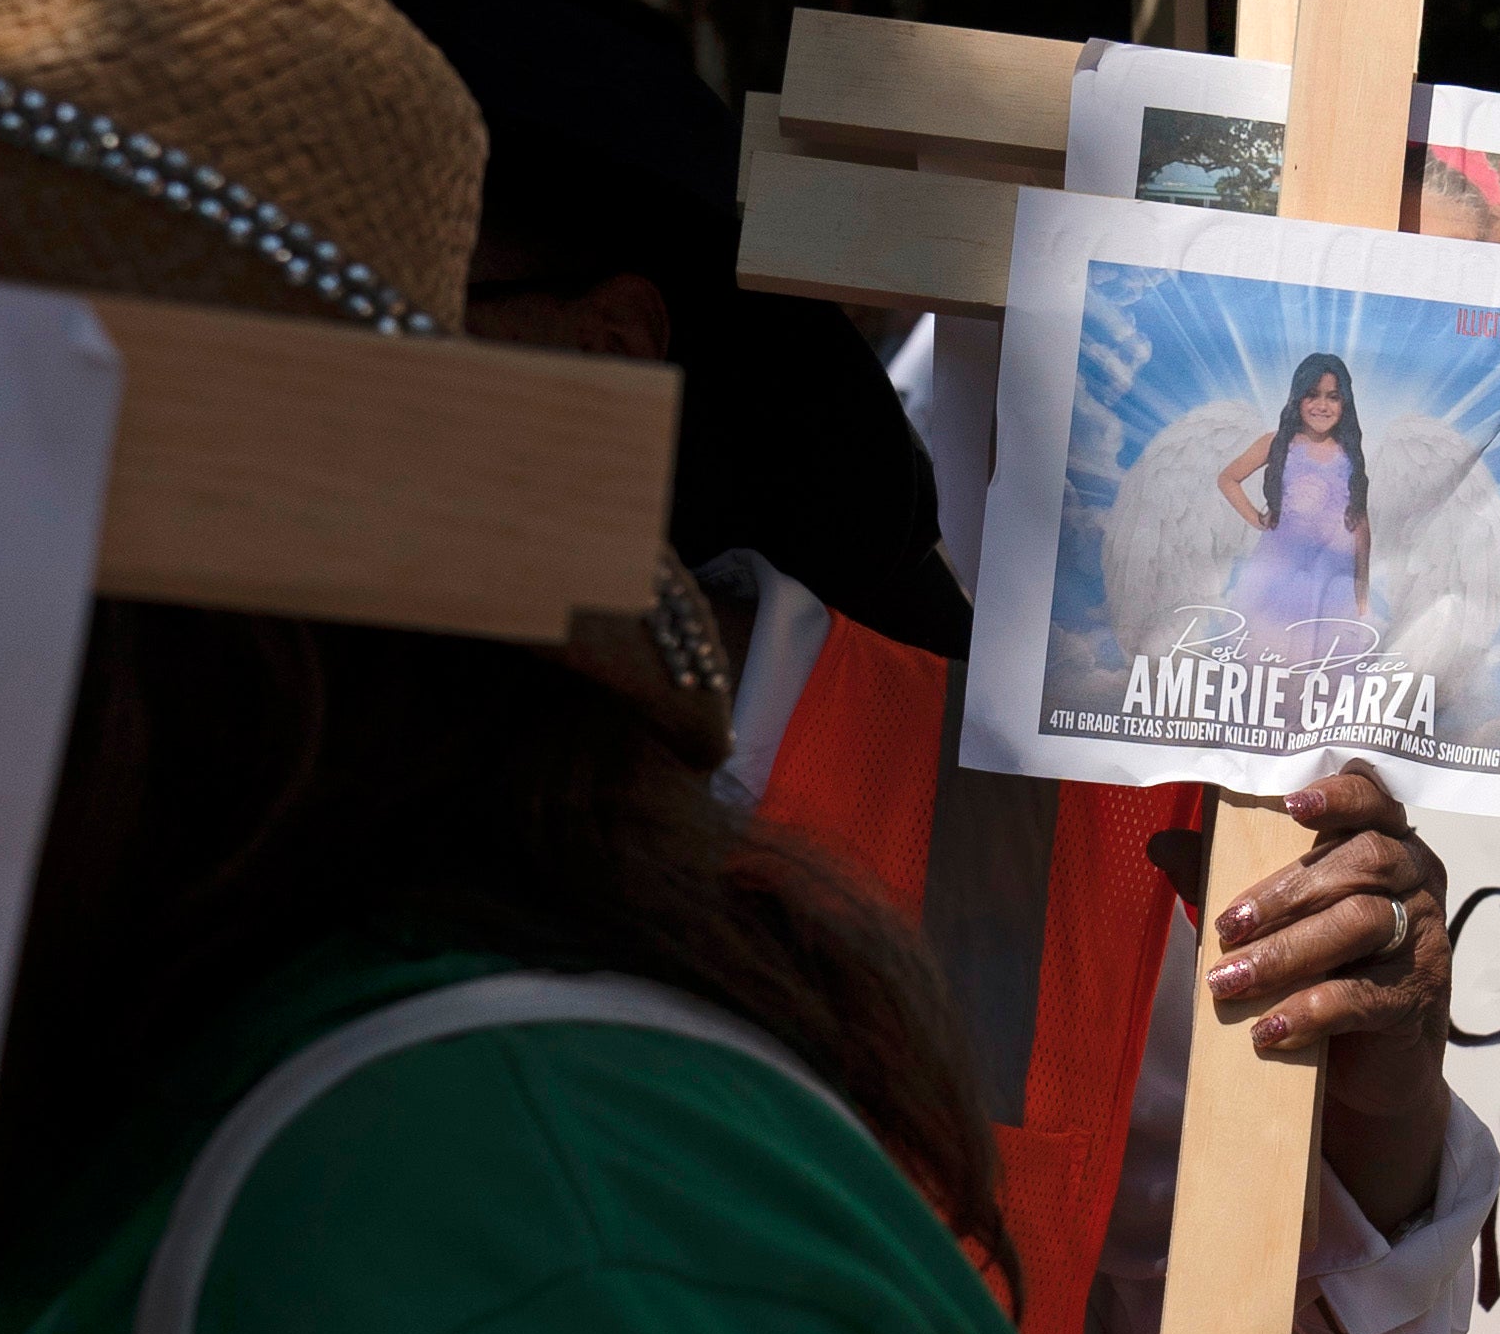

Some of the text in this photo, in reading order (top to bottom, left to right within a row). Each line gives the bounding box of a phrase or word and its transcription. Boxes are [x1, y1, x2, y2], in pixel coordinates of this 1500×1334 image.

[1158, 605, 1408, 685] Rest in Peace
[1122, 655, 1436, 737] AMERIE GARZA
[1050, 710, 1500, 768] 4TH GRADE TEXAS STUDENT KILLED IN ROBB ELEMENTARY MASS SHOOTING
